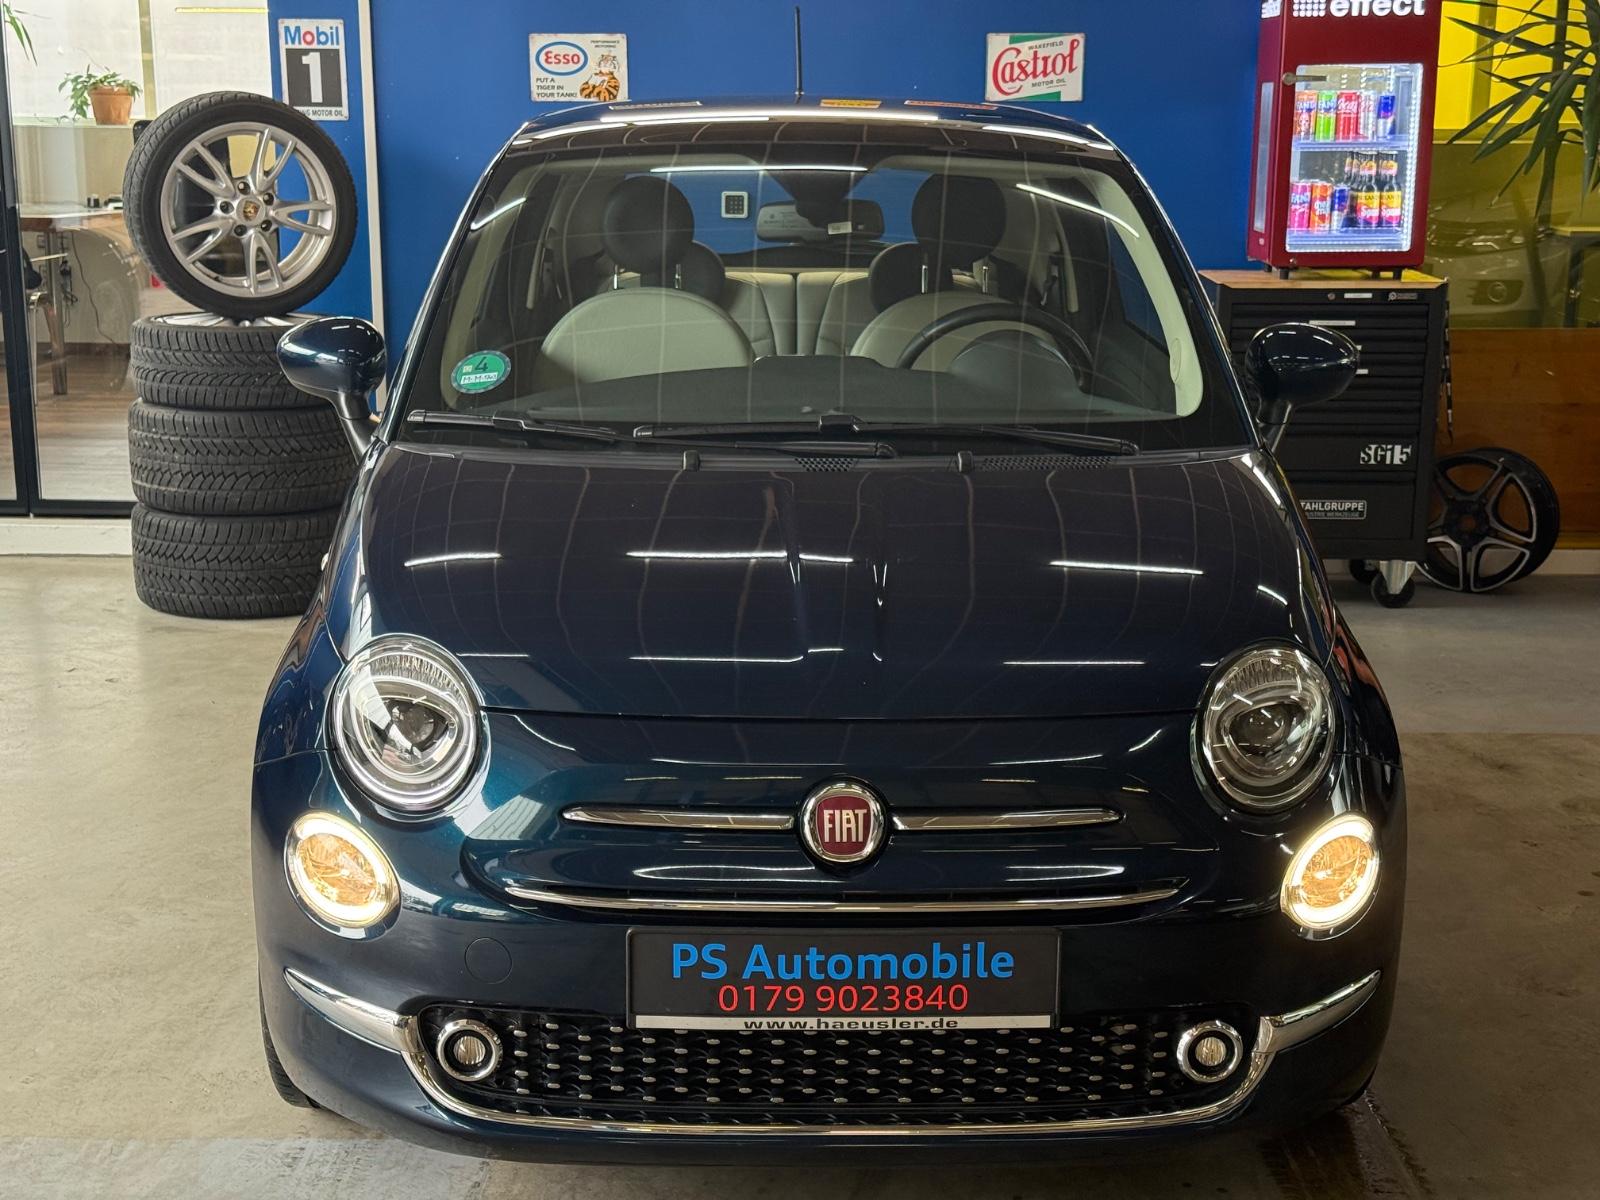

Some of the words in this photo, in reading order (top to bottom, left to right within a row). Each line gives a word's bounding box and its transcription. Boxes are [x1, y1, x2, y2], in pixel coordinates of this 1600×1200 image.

[283, 25, 340, 46] Mobil
[1027, 40, 1064, 51] WAKEFIELD
[301, 51, 323, 103] 1
[992, 38, 1081, 97] Castrol
[1031, 79, 1054, 88] MOTOR
[311, 109, 333, 117] MOTOR
[334, 109, 343, 117] OIL
[474, 356, 488, 371] 4
[823, 809, 868, 843] FIAT
[672, 943, 728, 980] PS
[742, 941, 1015, 980] Automobile
[718, 984, 806, 1012] 0179
[815, 984, 969, 1012] 9023840
[743, 1017, 959, 1030] www.haeusler.de
